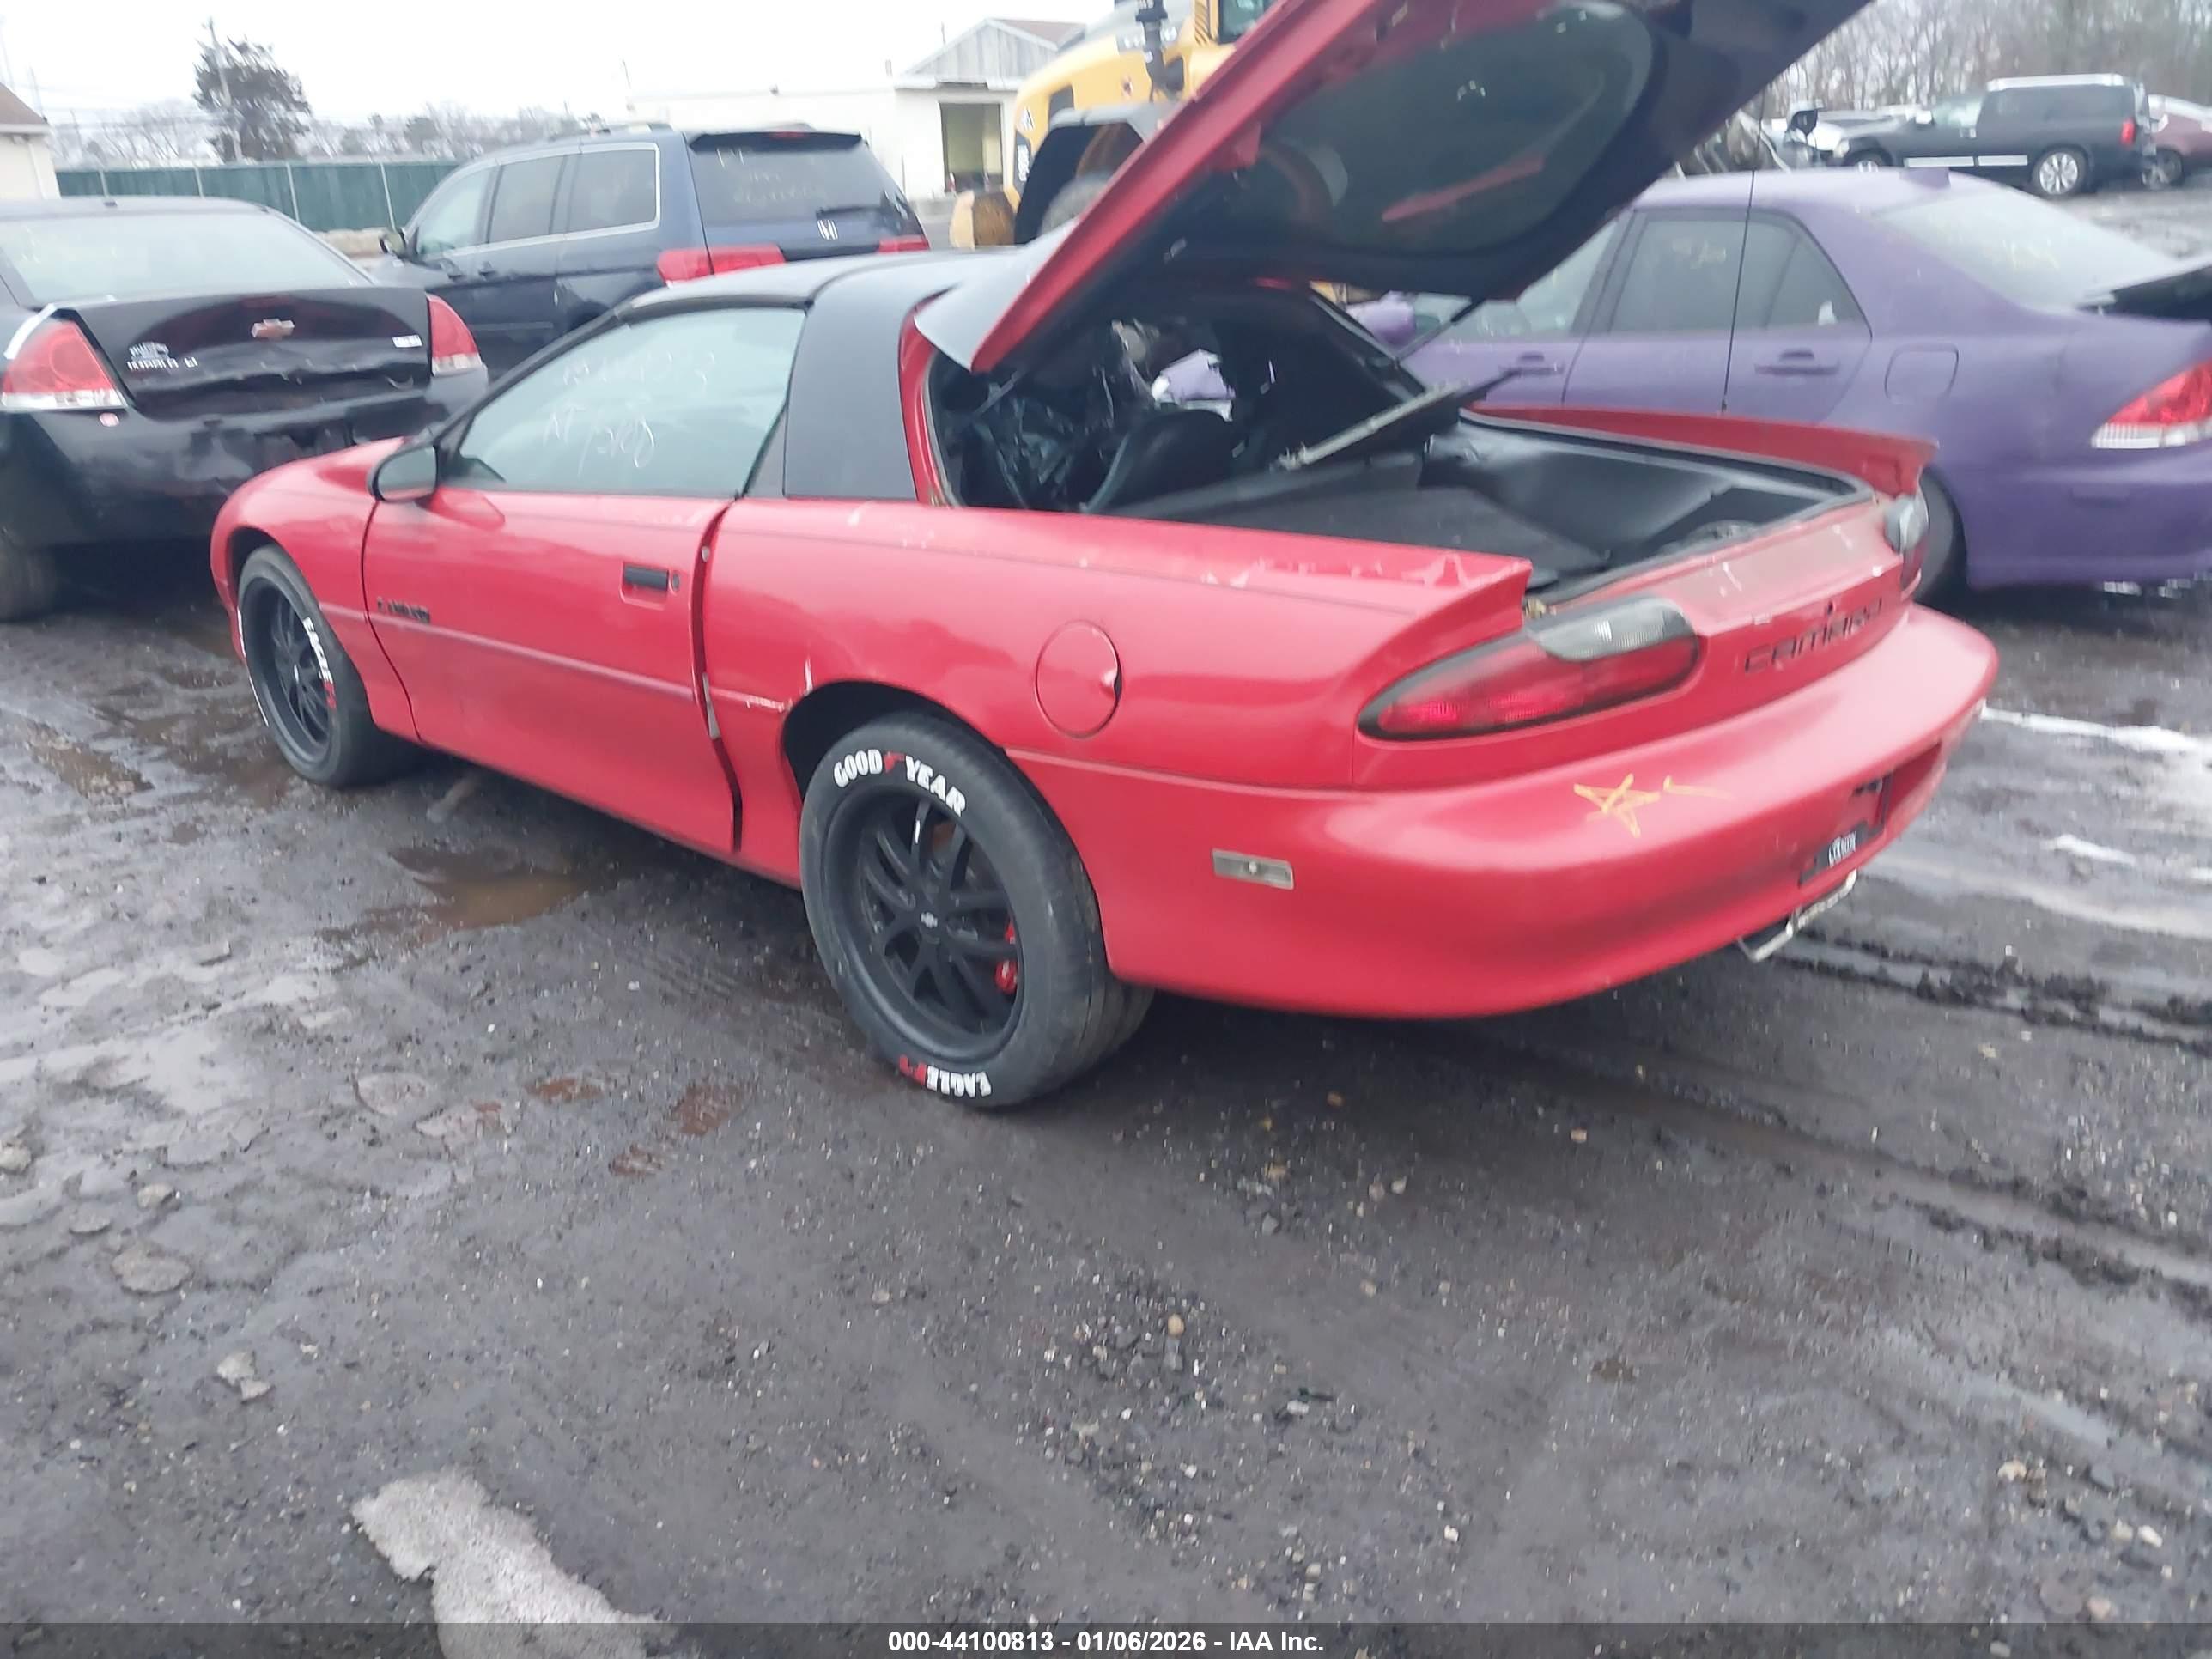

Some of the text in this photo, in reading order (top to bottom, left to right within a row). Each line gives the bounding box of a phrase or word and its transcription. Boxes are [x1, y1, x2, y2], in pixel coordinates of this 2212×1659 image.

[834, 749, 967, 817] GOOD YEAR
[926, 1065, 993, 1098] EAGLE
